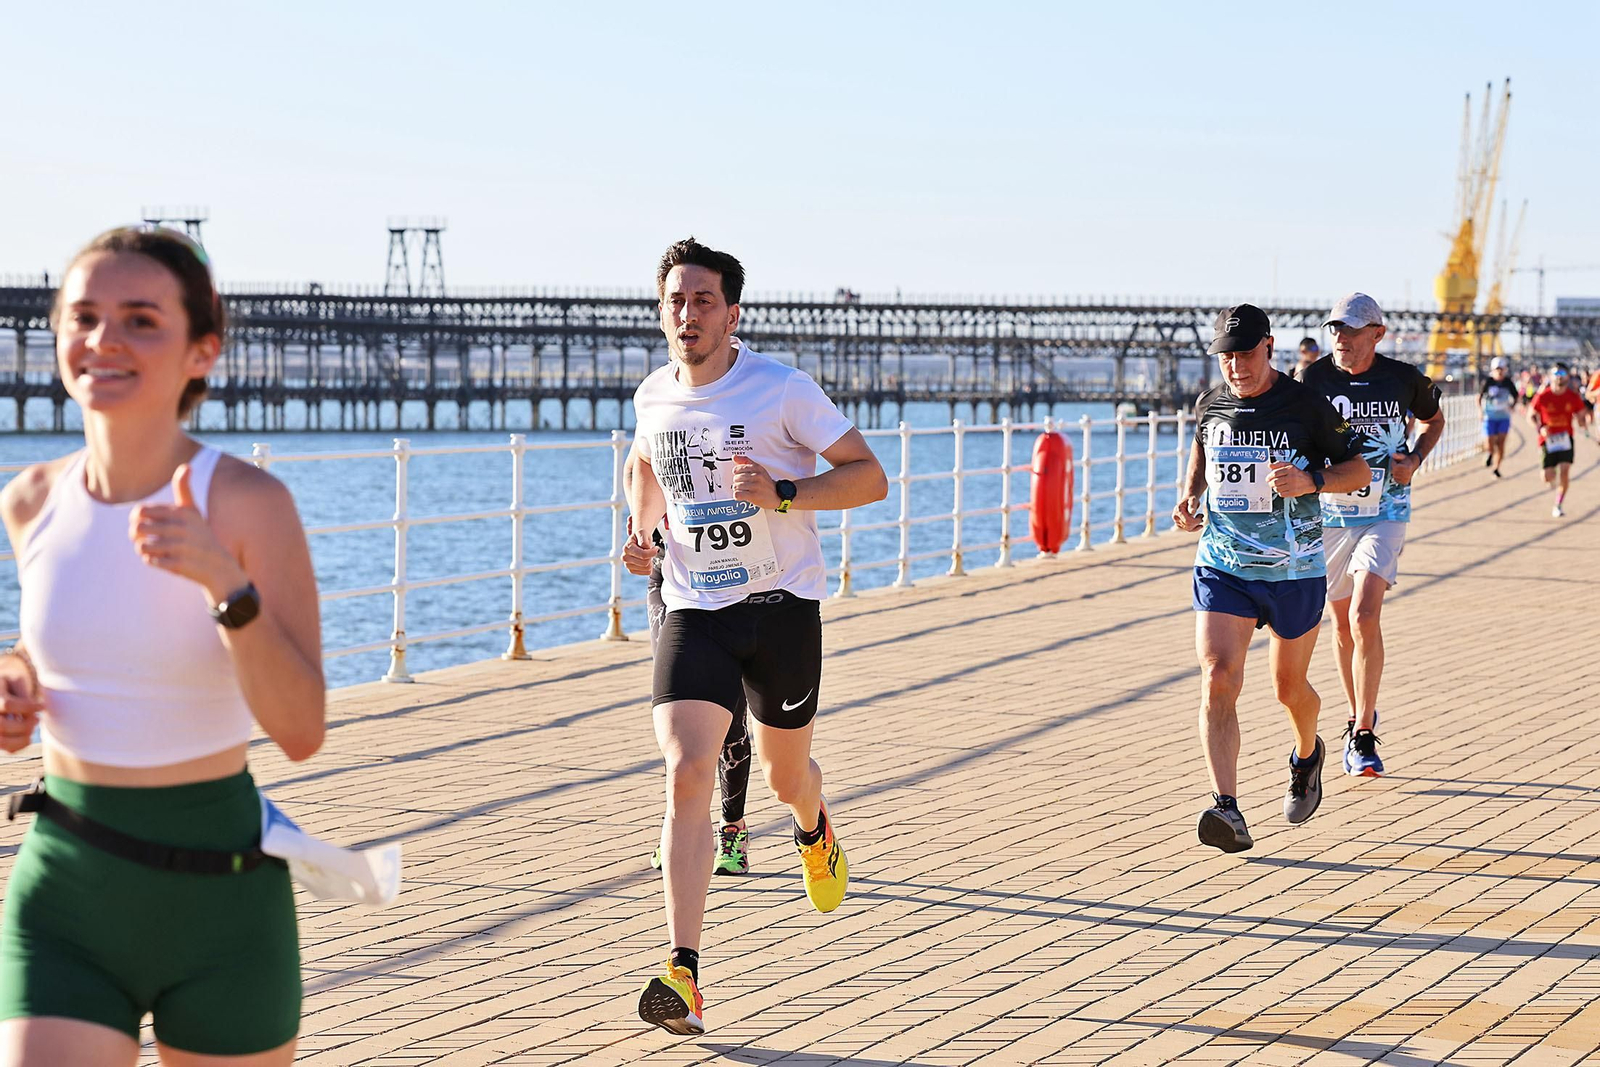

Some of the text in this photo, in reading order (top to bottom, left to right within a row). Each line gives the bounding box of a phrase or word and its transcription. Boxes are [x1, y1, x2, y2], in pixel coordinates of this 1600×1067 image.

[1350, 401, 1401, 418] HUELVA
[1231, 430, 1290, 448] HUELVA
[1214, 463, 1256, 483] 581
[688, 521, 752, 552] 799
[698, 569, 742, 584] Wayalia
